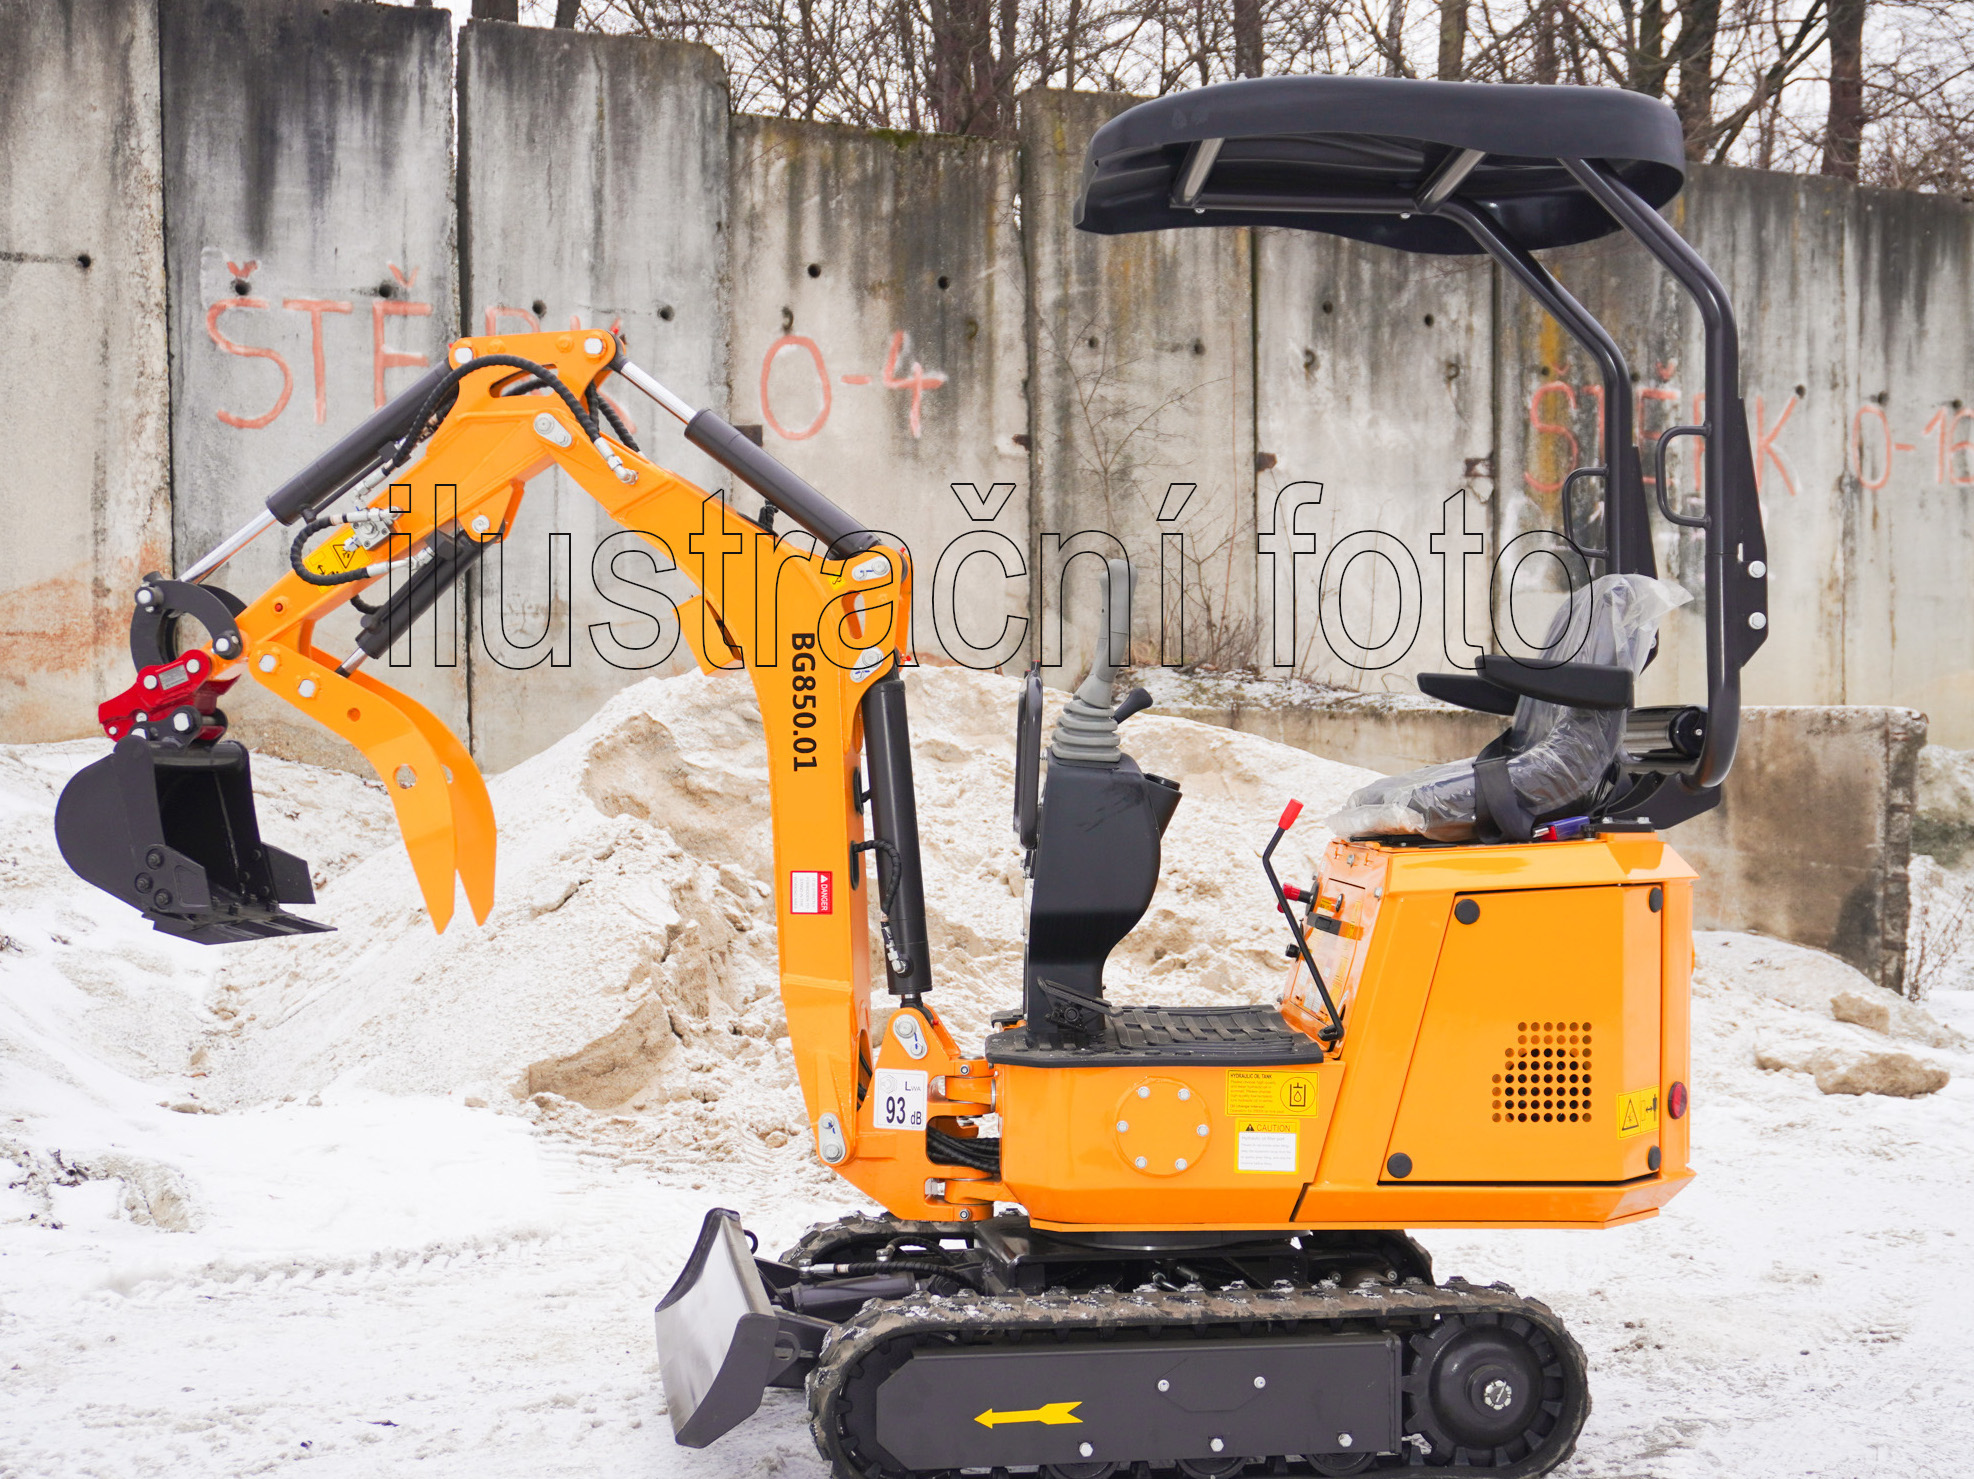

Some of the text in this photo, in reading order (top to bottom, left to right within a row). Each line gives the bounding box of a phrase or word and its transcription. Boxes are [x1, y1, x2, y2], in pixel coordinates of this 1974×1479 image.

[206, 259, 948, 440] ŠTĚ 0-4
[791, 632, 818, 772] BG850.01
[820, 884, 828, 911] DANGER
[886, 1096, 922, 1125] 93 dB
[1256, 1123, 1291, 1133] CAUTION
